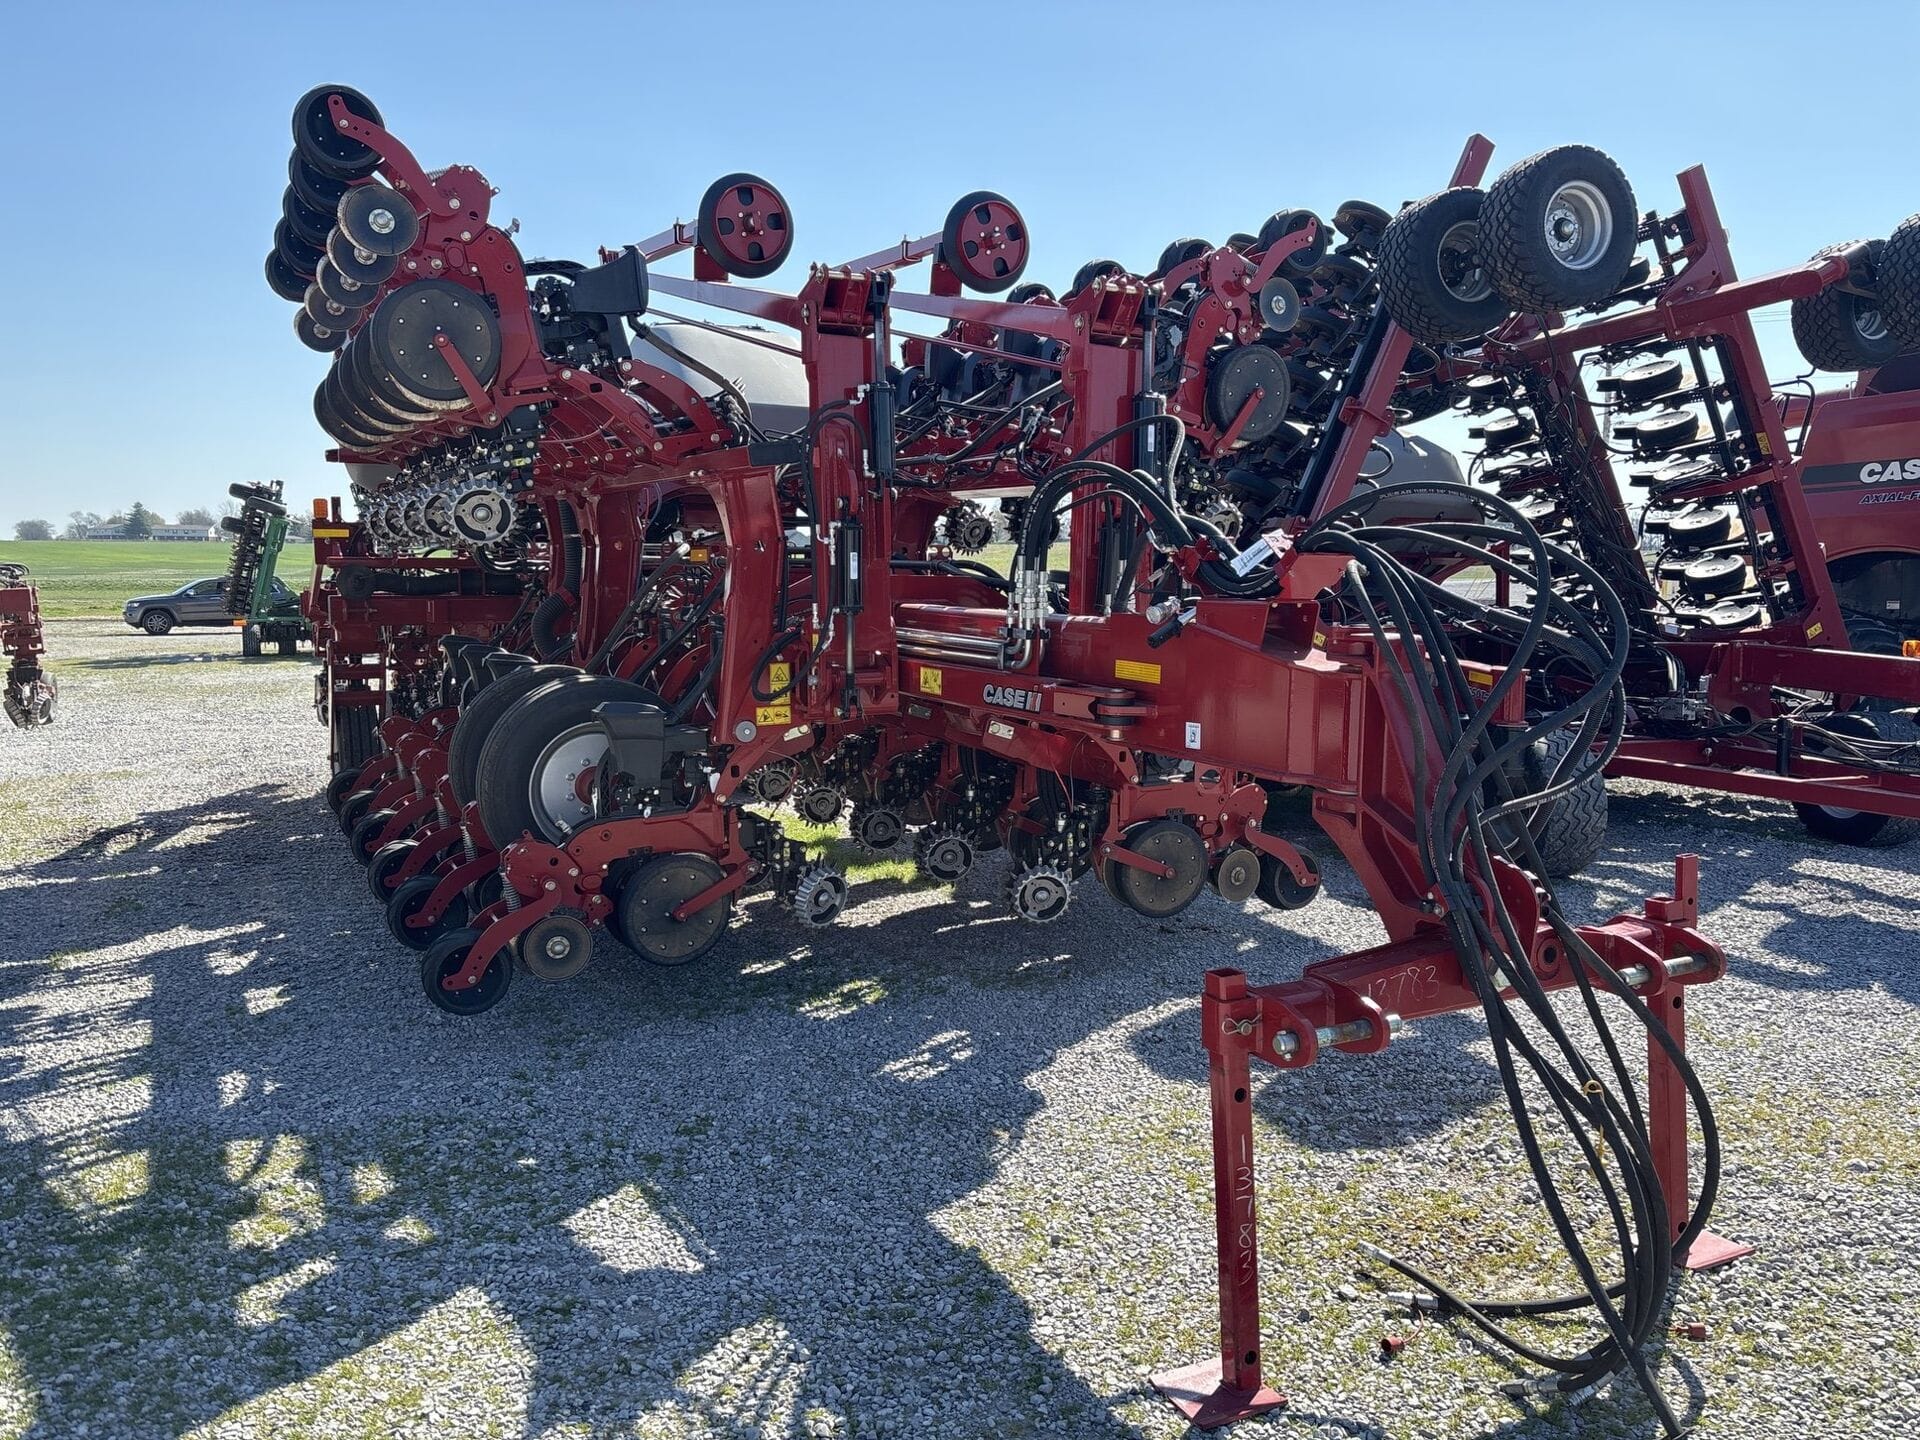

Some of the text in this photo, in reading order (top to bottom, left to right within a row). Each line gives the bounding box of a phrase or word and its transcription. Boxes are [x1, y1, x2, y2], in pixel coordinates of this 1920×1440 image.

[1858, 490, 1920, 505] AXIAL-F
[982, 684, 1026, 710] CASE
[1367, 965, 1440, 1010] 13783
